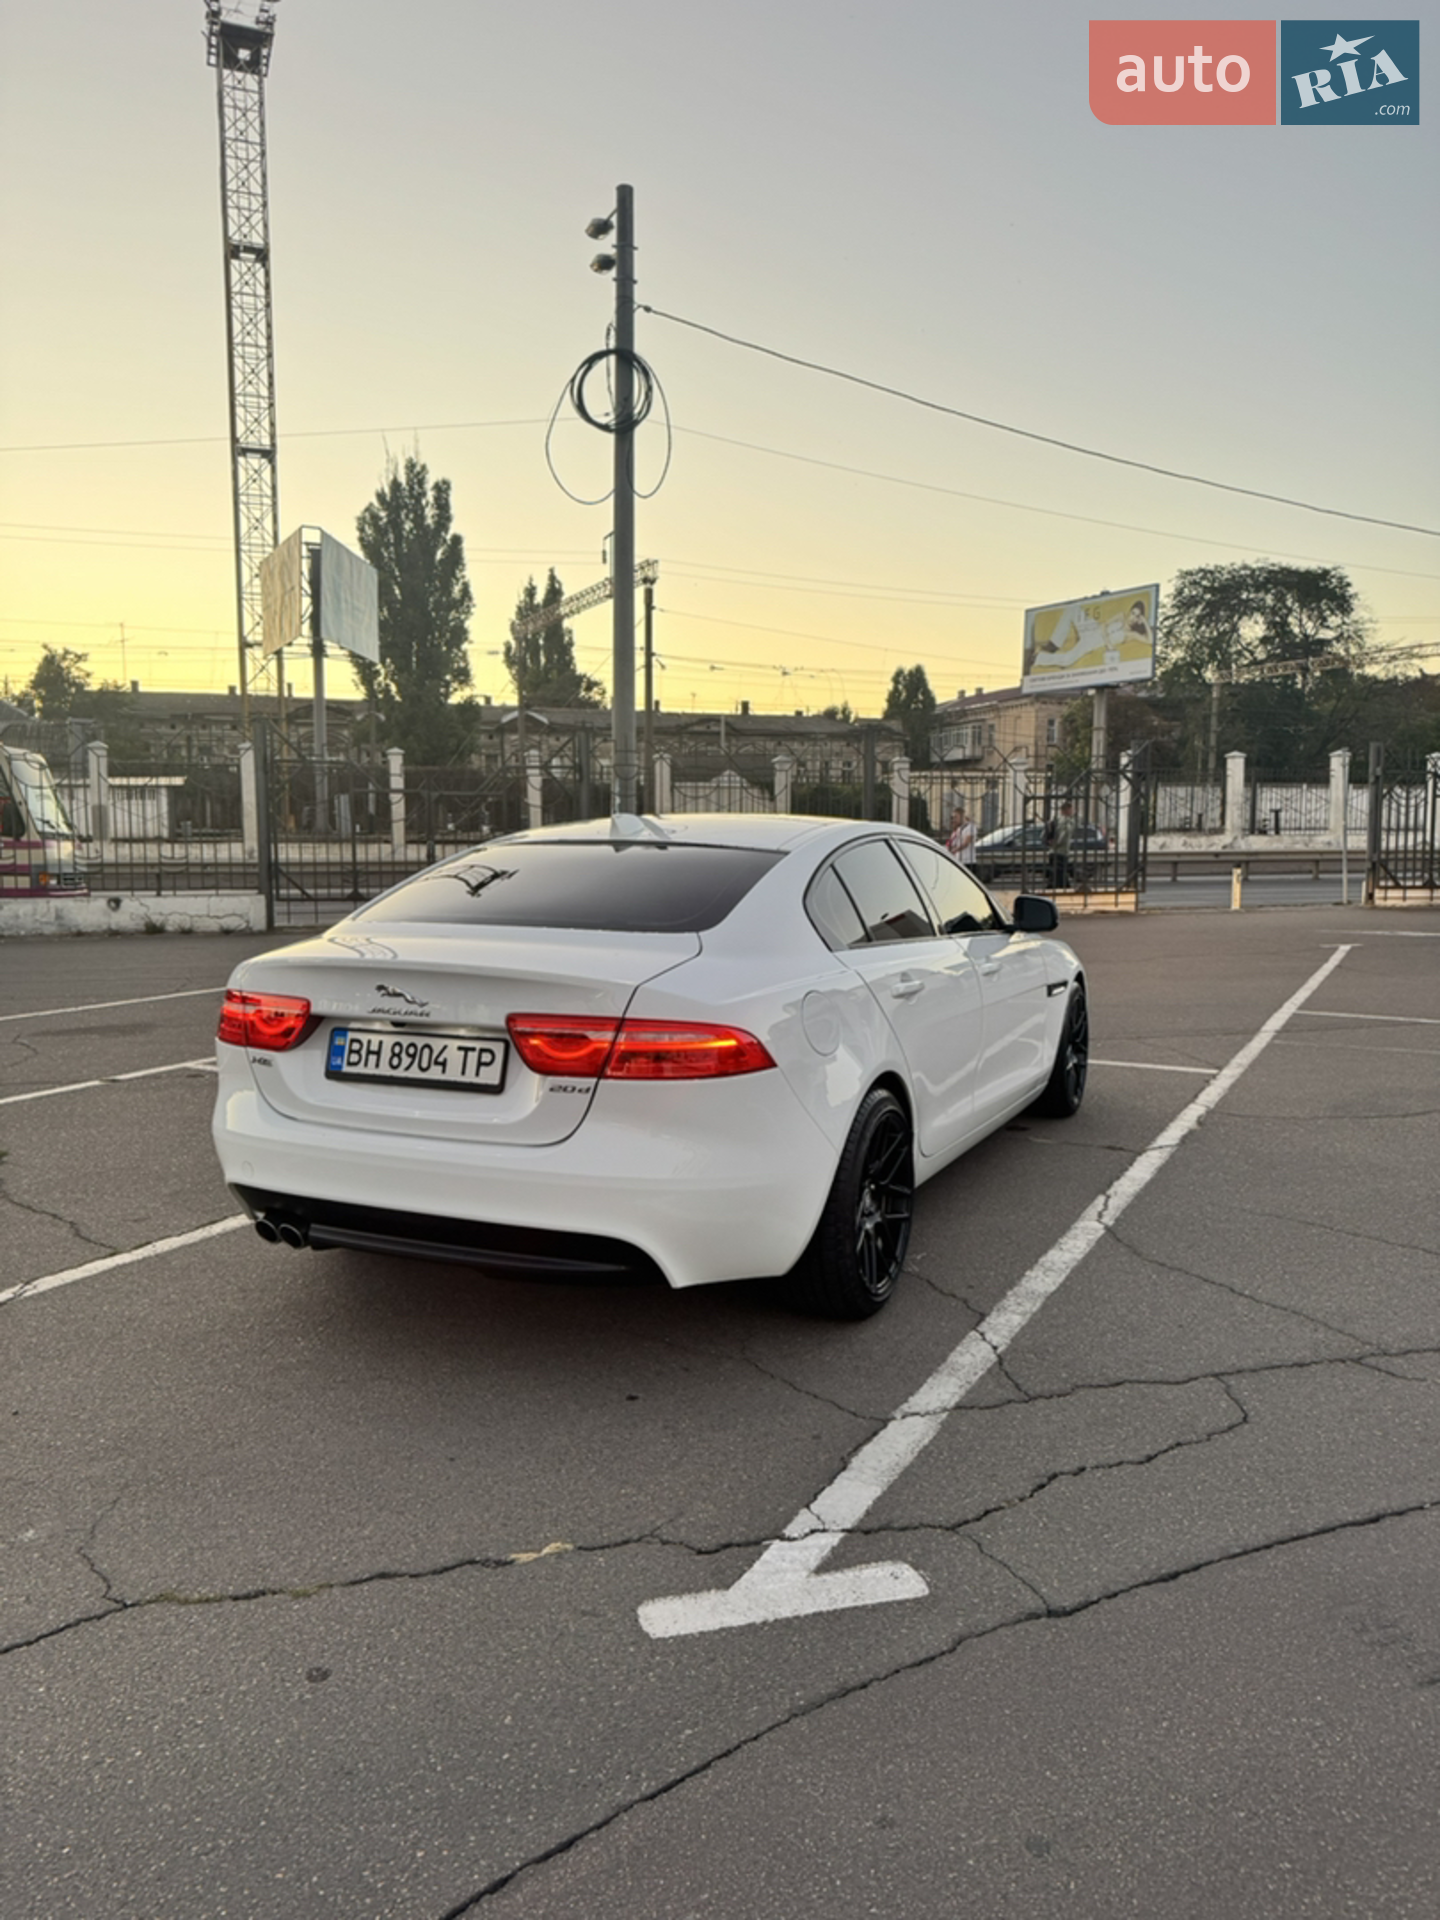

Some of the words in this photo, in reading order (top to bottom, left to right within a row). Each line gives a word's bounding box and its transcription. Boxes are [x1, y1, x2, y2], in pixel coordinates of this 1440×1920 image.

[367, 1007, 431, 1018] JAGUAR
[346, 1038, 383, 1069] BH
[388, 1041, 448, 1075] 8904
[457, 1046, 496, 1077] TP
